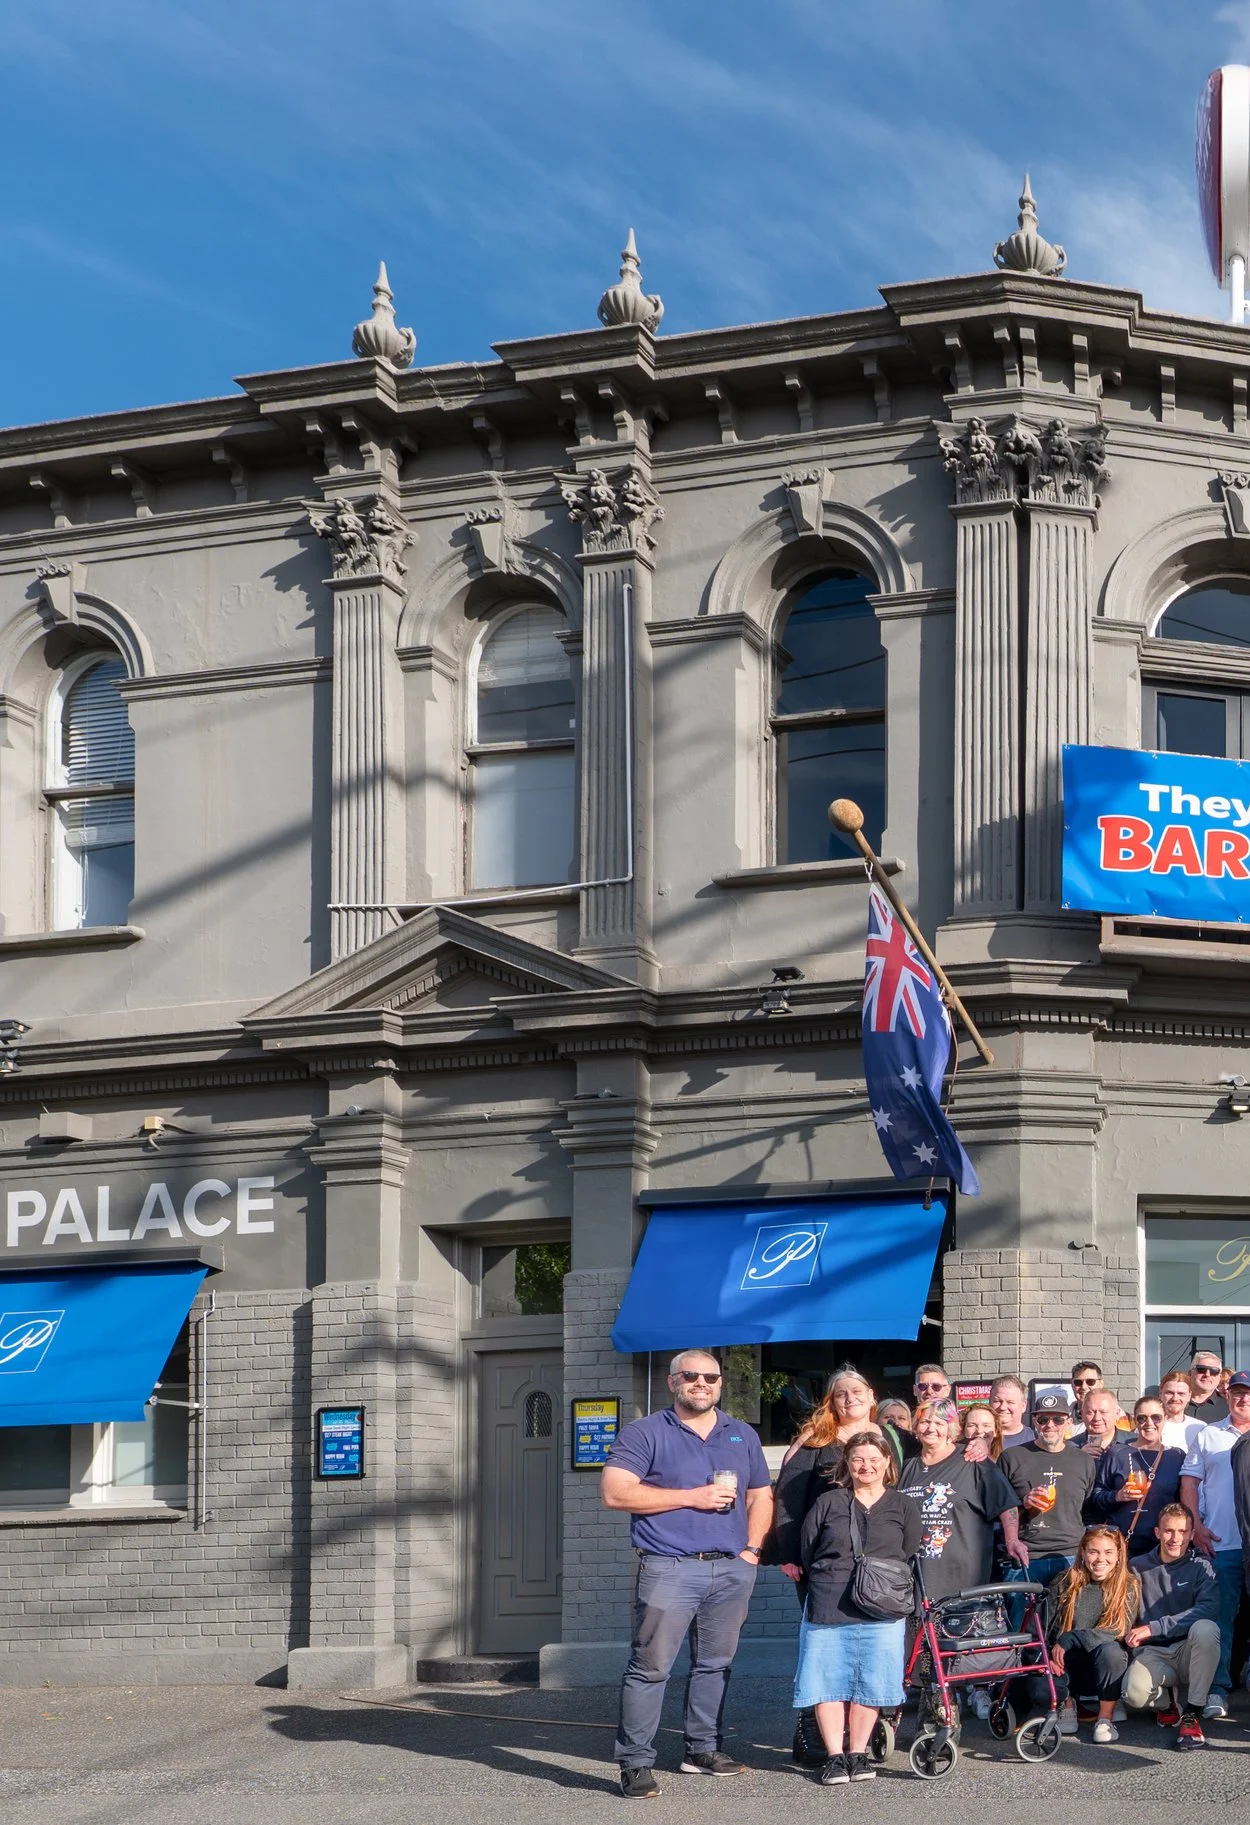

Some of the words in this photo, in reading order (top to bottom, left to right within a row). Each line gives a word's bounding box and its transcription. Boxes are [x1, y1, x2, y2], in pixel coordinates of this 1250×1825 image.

[6, 1176, 275, 1247] PALACE
[748, 1231, 821, 1279] P
[958, 1385, 992, 1395] CHRISTMAS
[578, 1403, 604, 1412] Thursday
